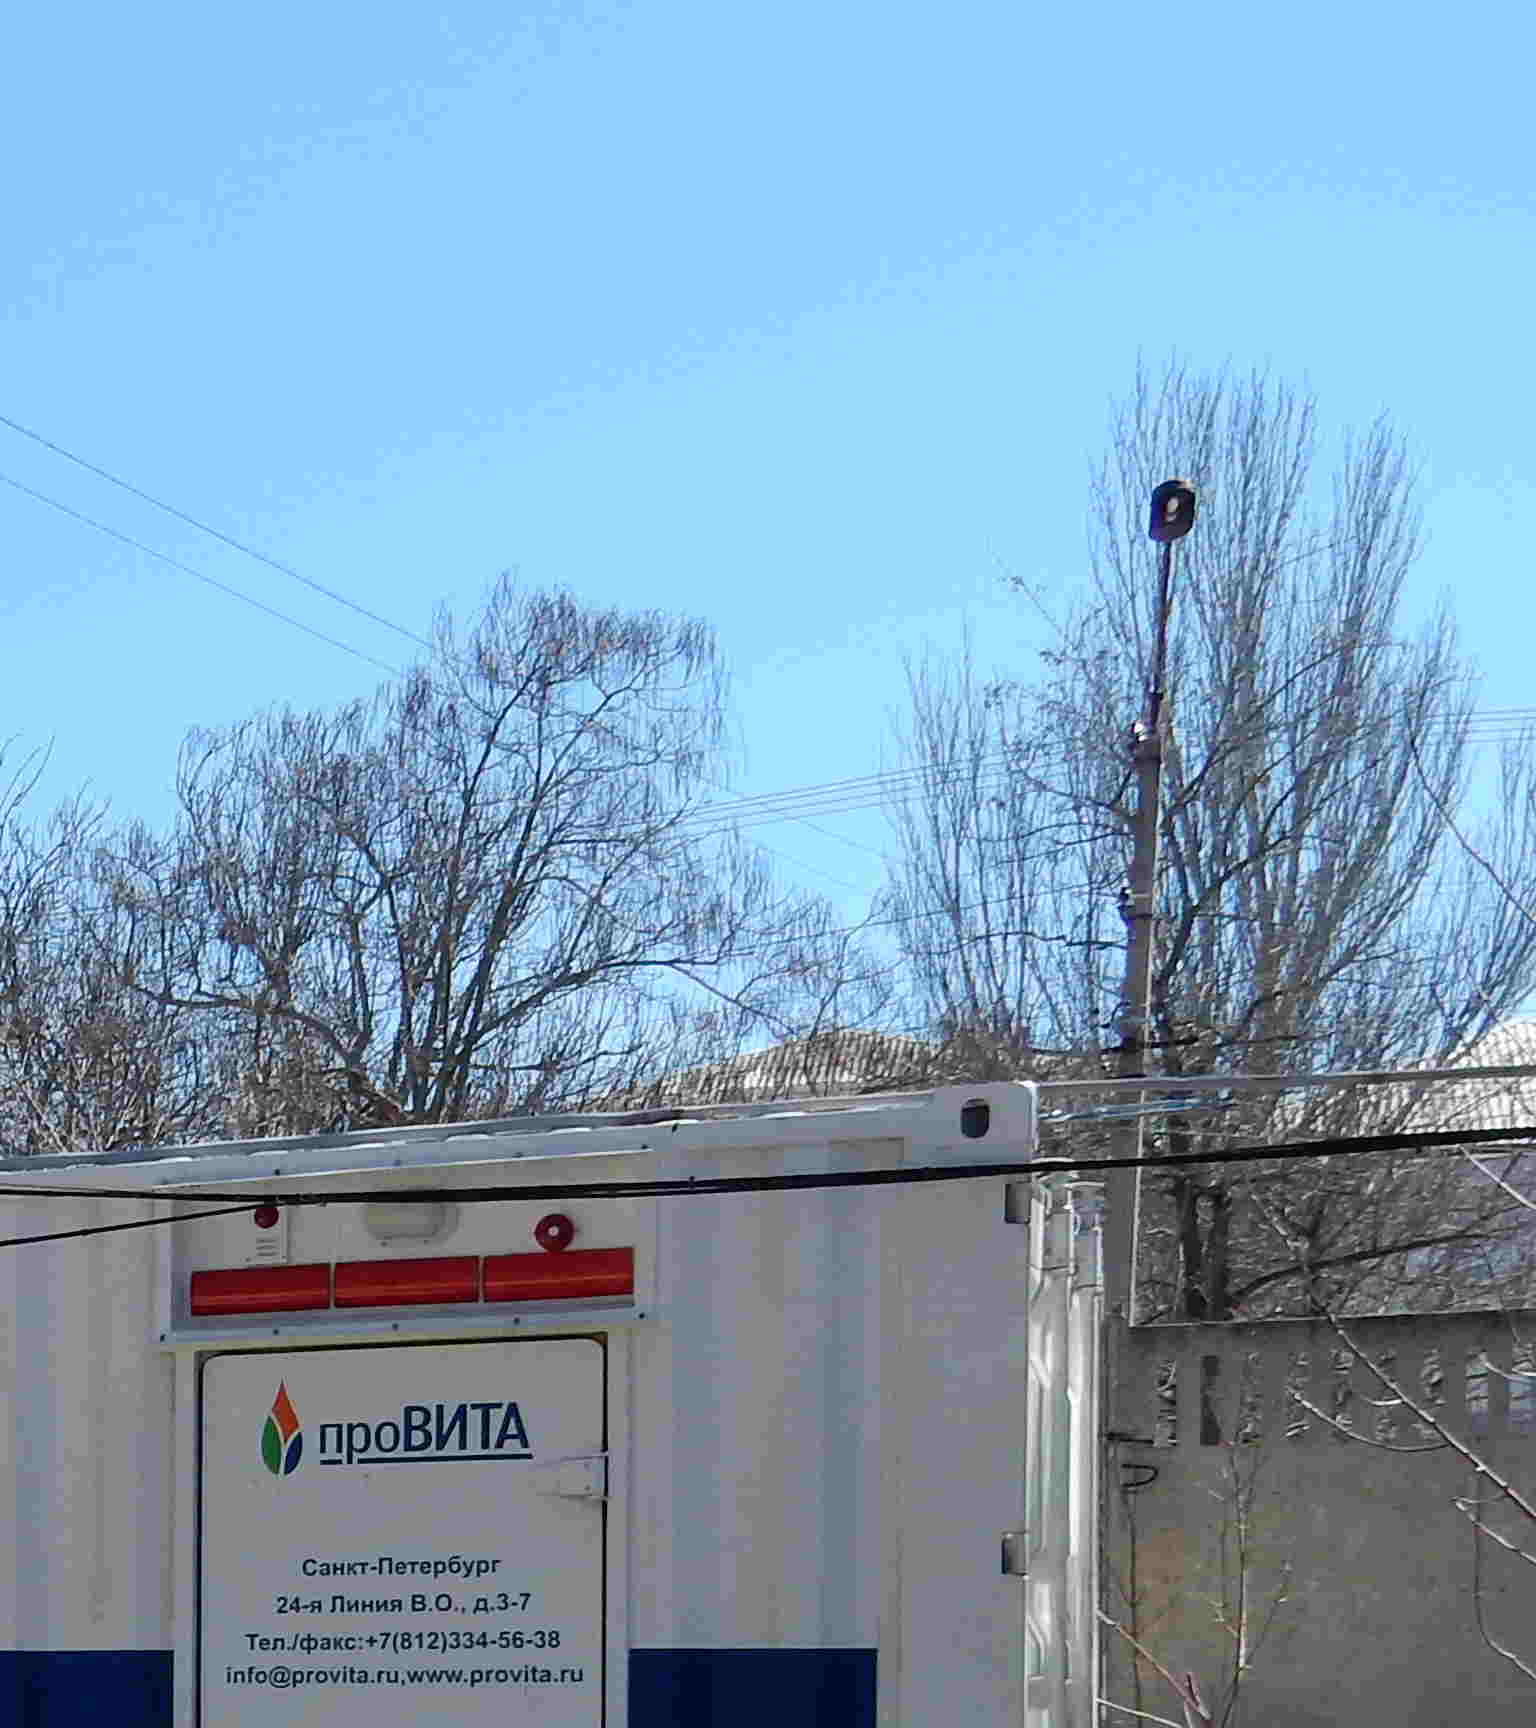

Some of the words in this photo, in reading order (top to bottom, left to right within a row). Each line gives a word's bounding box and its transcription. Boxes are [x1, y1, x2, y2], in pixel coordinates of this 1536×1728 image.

[319, 1402, 530, 1464] проВИТА
[302, 1556, 501, 1578] Санкт-Петербург
[276, 1596, 322, 1614] 24-я
[330, 1595, 403, 1613] Линия
[411, 1593, 466, 1614] В.О.,
[473, 1592, 531, 1614] д.3-7
[245, 1630, 562, 1654] Тел./факс:+7(812)334-56-38
[226, 1664, 585, 1689] info@provita.ru,www.provita.ru
